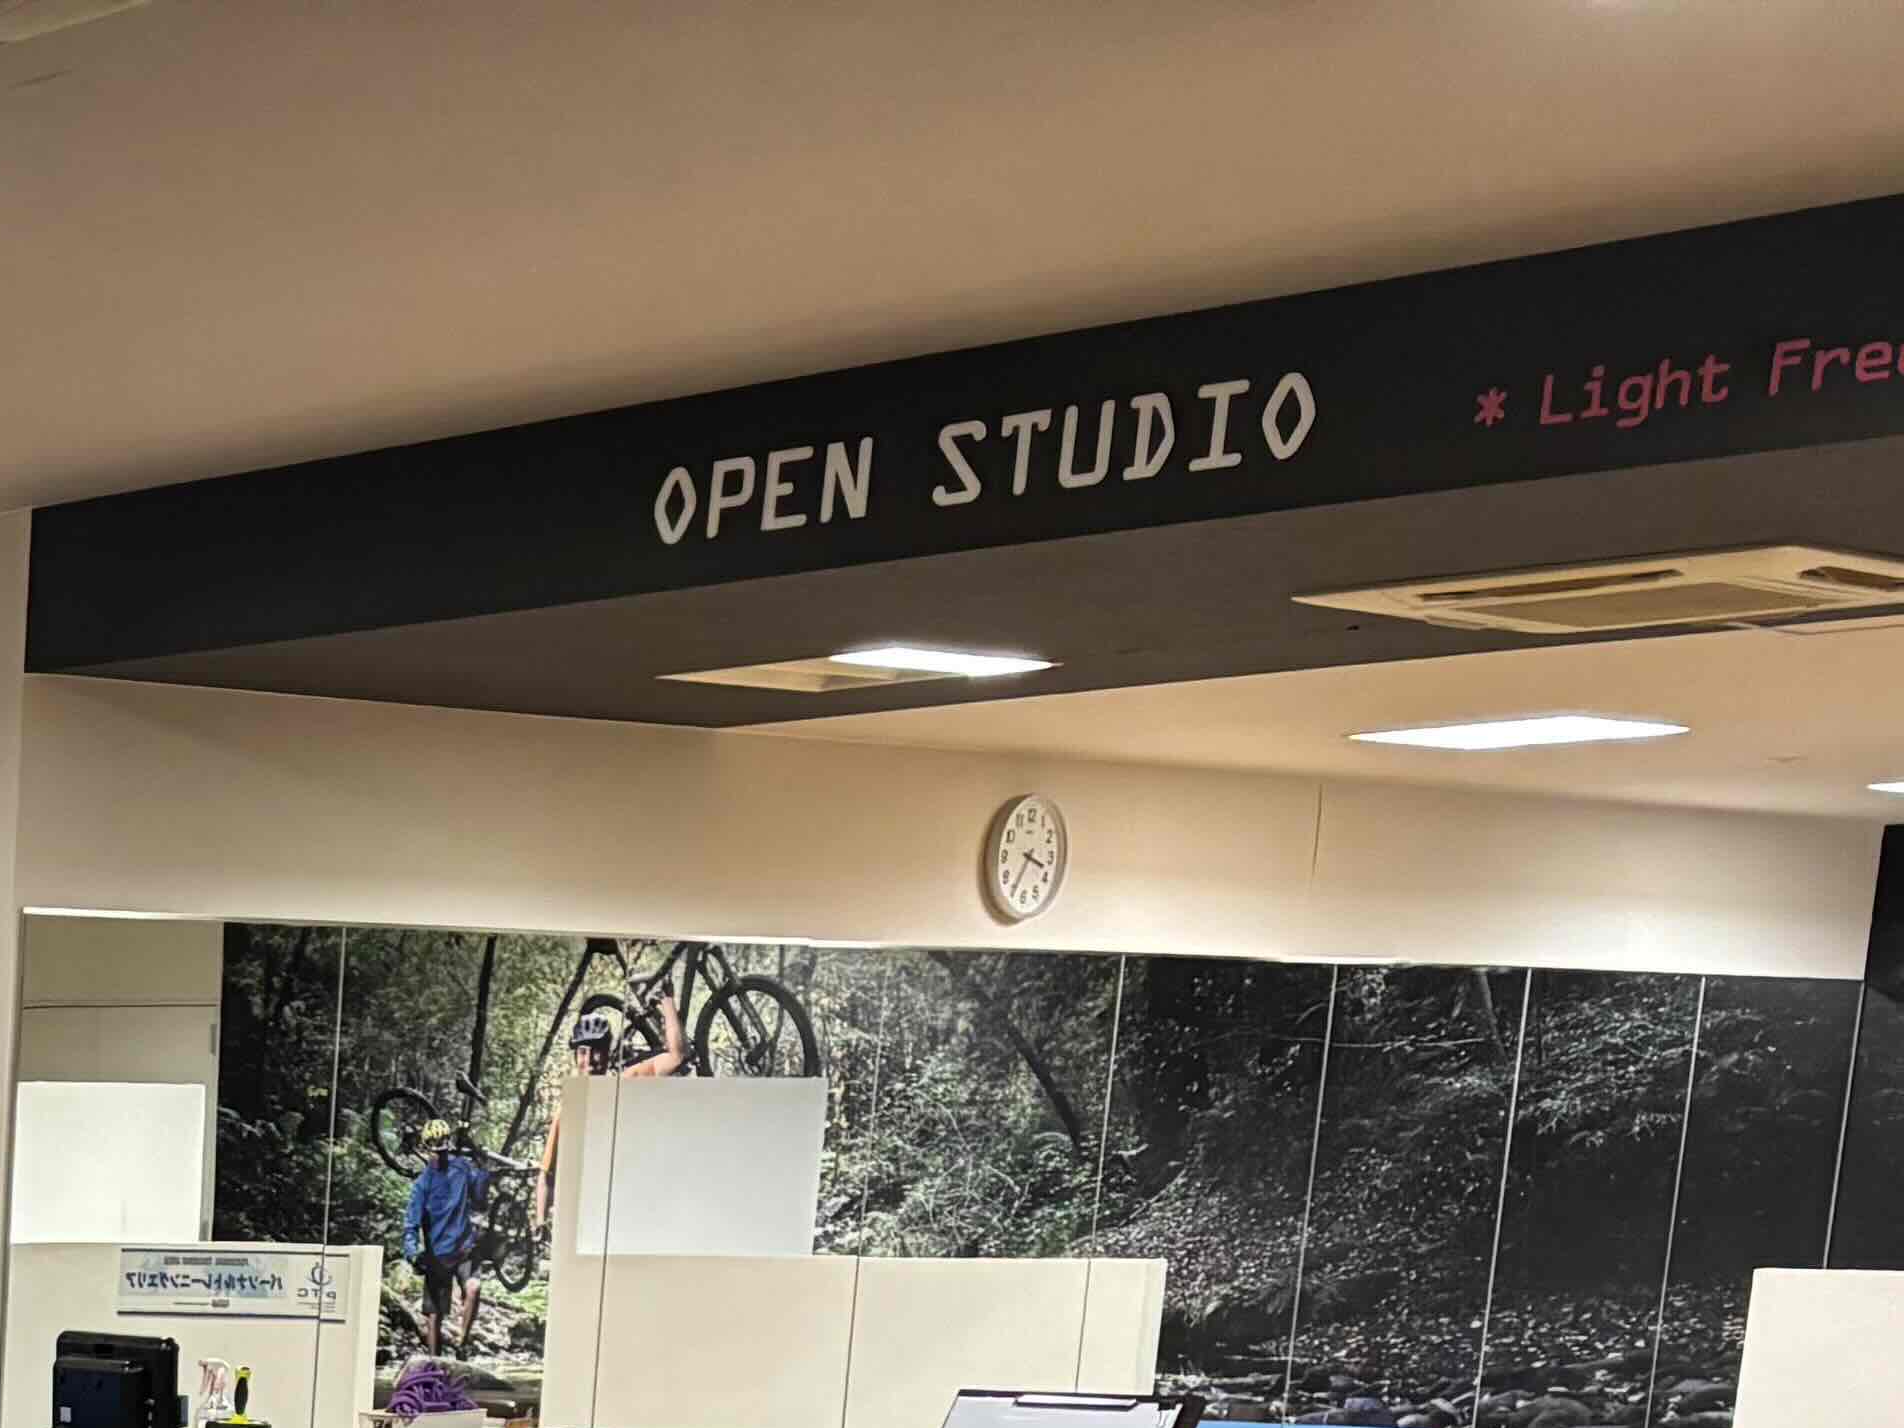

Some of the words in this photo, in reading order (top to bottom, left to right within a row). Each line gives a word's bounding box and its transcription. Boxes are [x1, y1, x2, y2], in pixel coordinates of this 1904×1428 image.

[1539, 354, 1731, 429] Light
[1767, 337, 1904, 397] Fre
[653, 436, 874, 545] OPEN
[931, 370, 1317, 508] STUDIO
